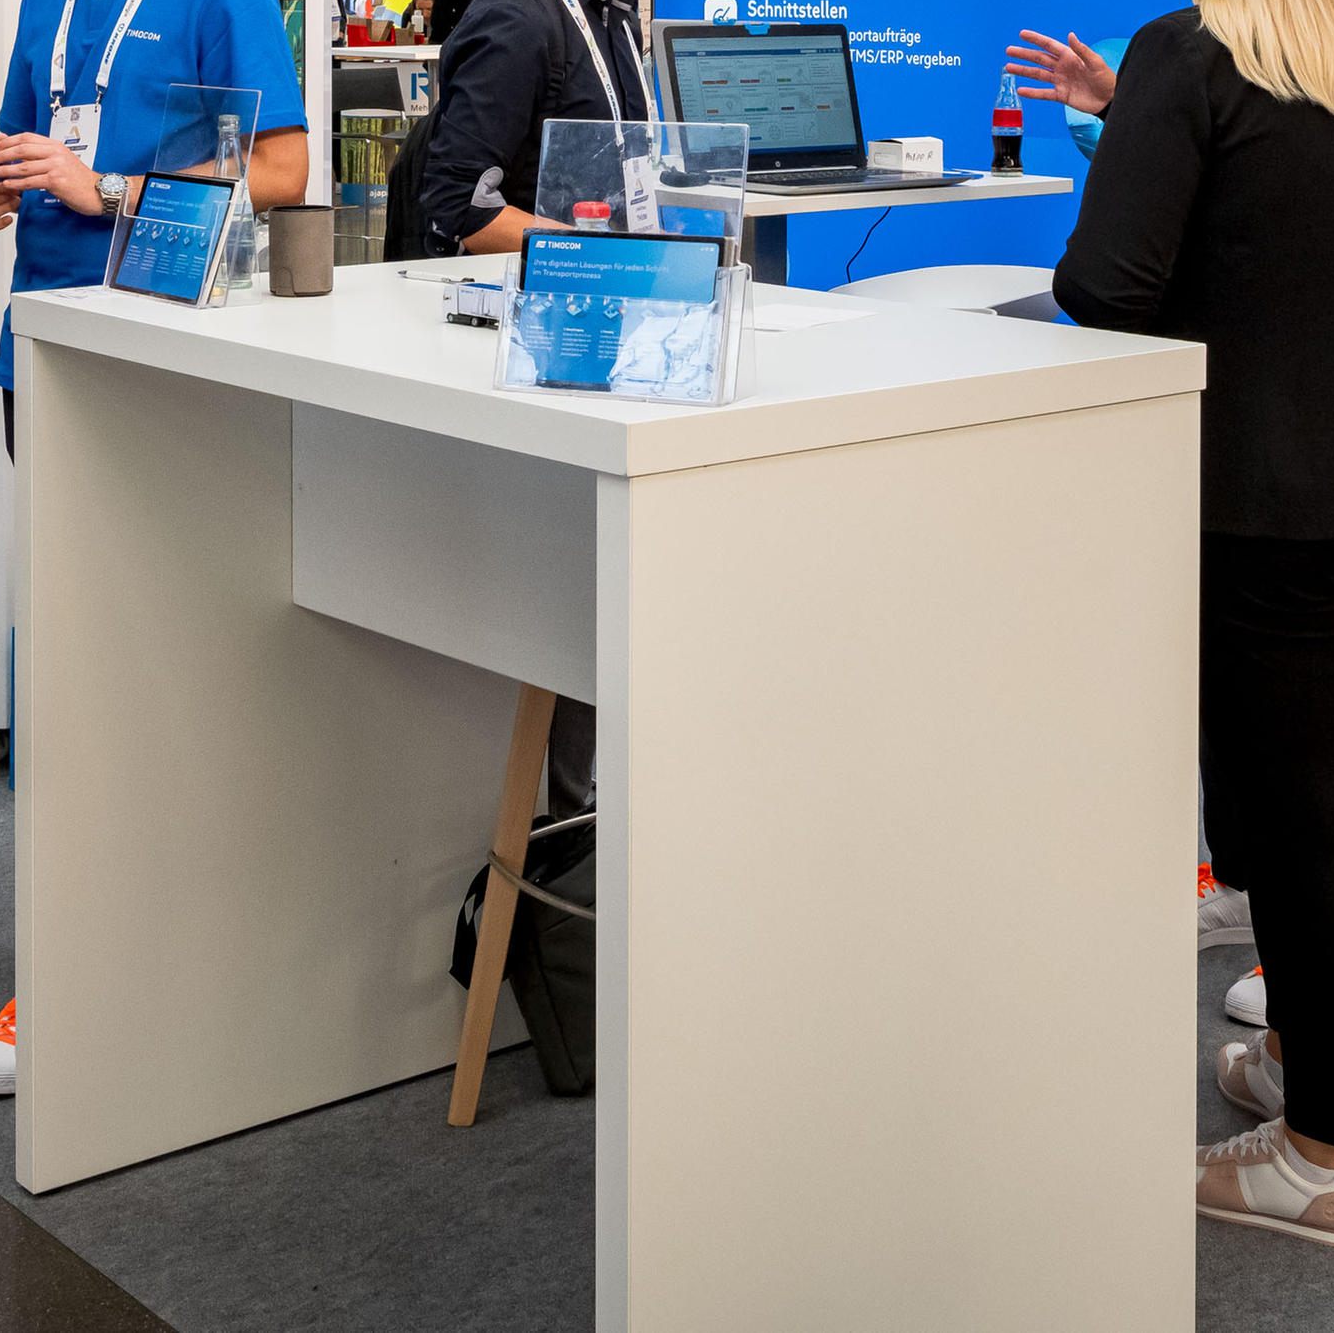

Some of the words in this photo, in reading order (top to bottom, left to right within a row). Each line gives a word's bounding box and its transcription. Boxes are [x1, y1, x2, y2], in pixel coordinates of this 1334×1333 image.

[747, 0, 848, 19] Schnittstellen
[126, 28, 161, 42] TIMOCOM
[104, 32, 120, 65] KRONE
[849, 48, 904, 64] TMS/ERP
[905, 51, 961, 69] vergeben
[548, 241, 581, 250] TIMOCOM
[548, 259, 578, 269] digitalen
[579, 260, 612, 271] Lösungen
